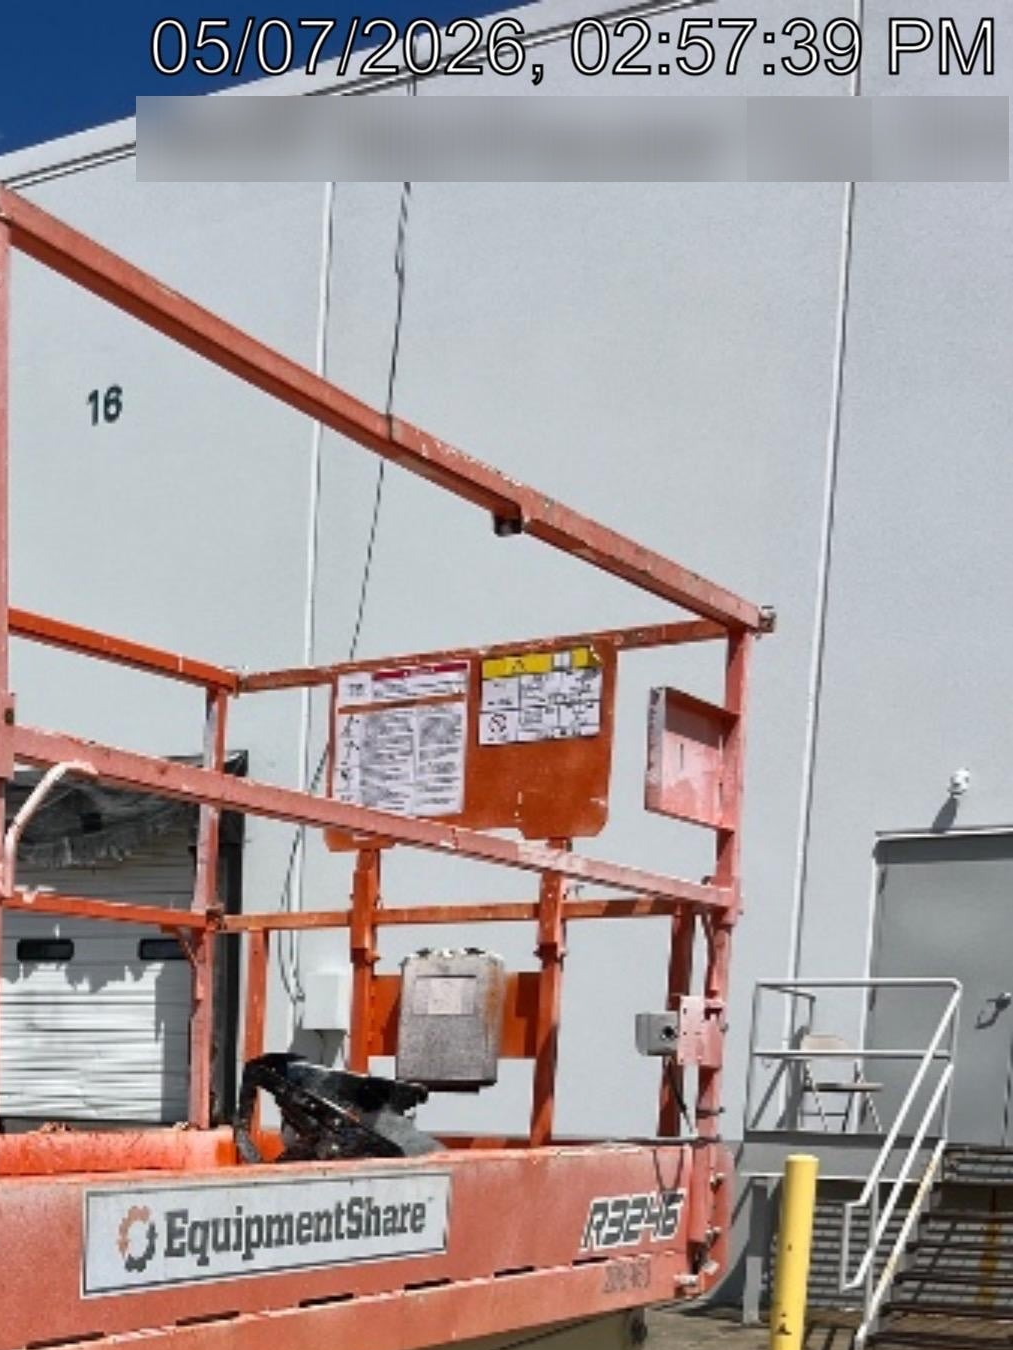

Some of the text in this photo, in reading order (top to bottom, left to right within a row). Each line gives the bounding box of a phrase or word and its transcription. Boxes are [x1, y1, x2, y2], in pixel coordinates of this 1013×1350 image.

[87, 384, 123, 426] 16
[163, 1196, 427, 1267] EquipmentShare
[580, 1189, 686, 1251] R3246
